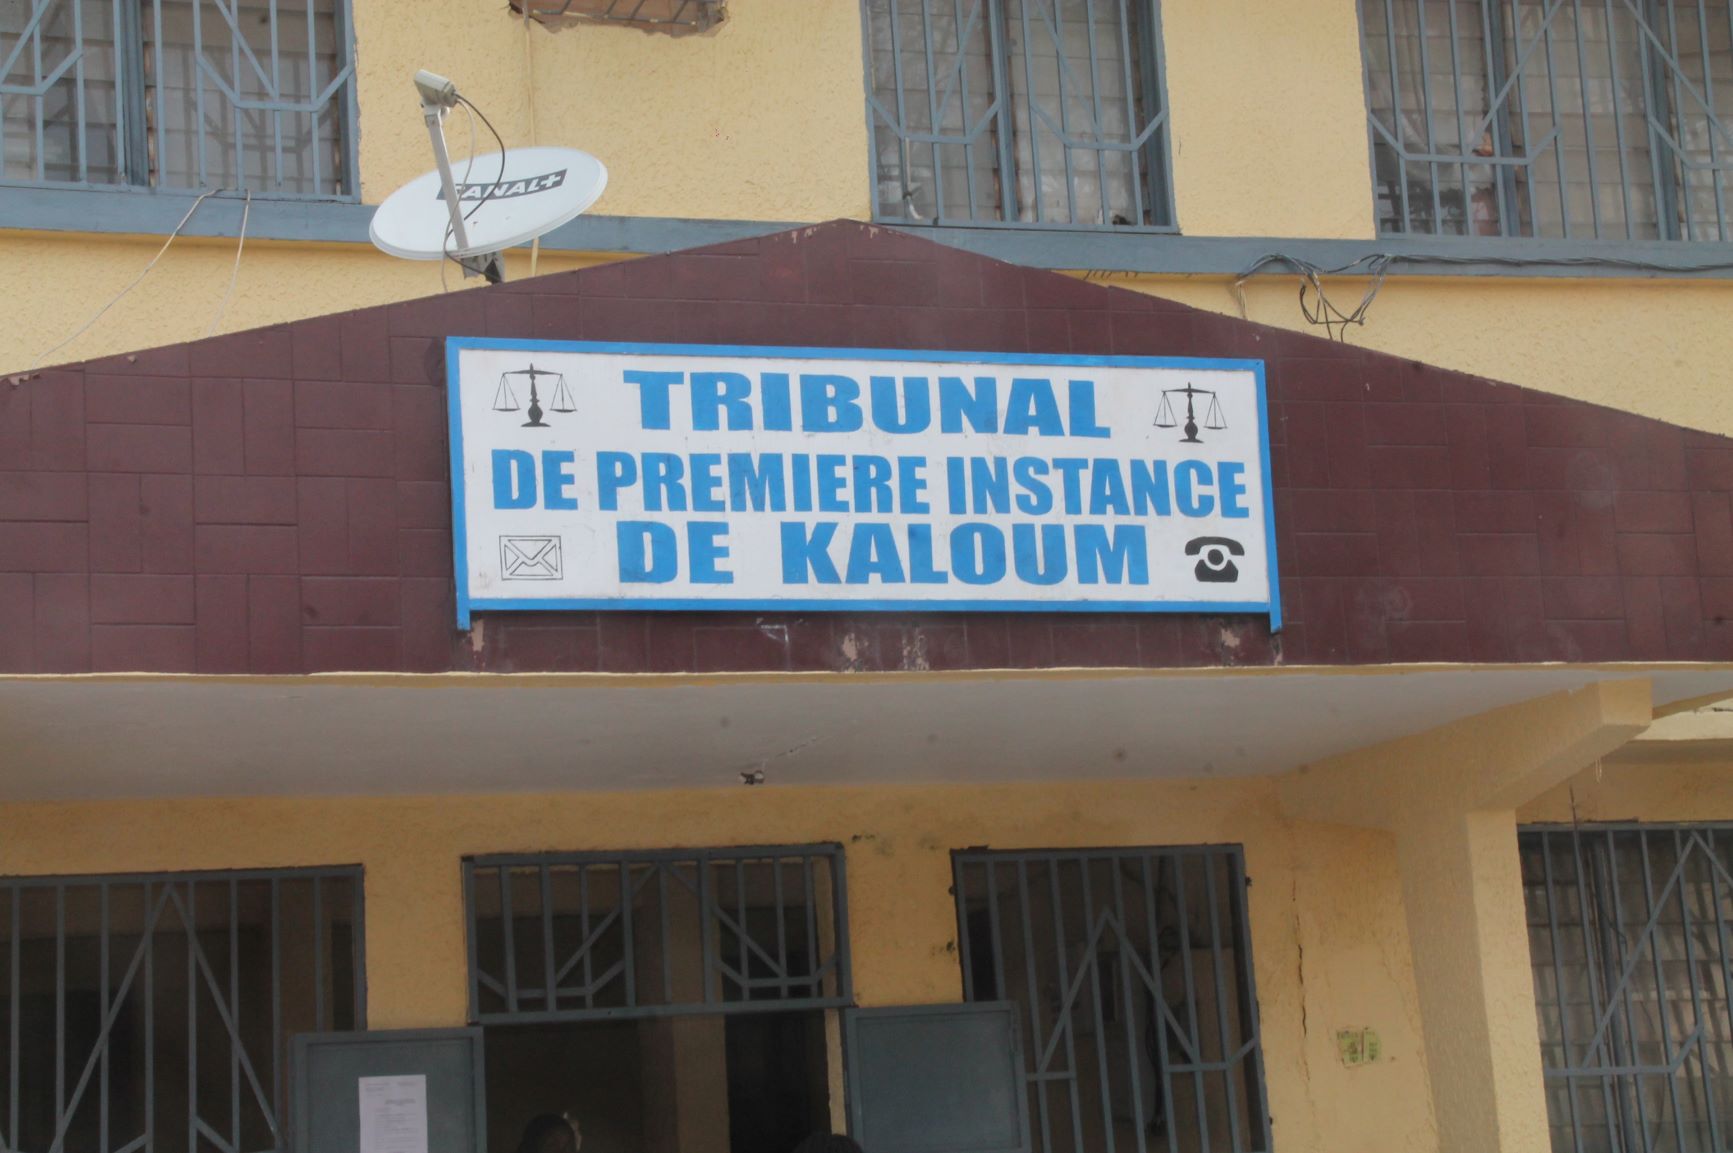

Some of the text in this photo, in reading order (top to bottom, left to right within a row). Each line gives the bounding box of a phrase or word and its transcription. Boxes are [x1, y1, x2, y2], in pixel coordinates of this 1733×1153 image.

[624, 370, 1111, 438] TRIBUNAL
[491, 448, 1249, 519] DE PREMIERE INSTANCE
[616, 521, 1150, 586] DE KALOUM
